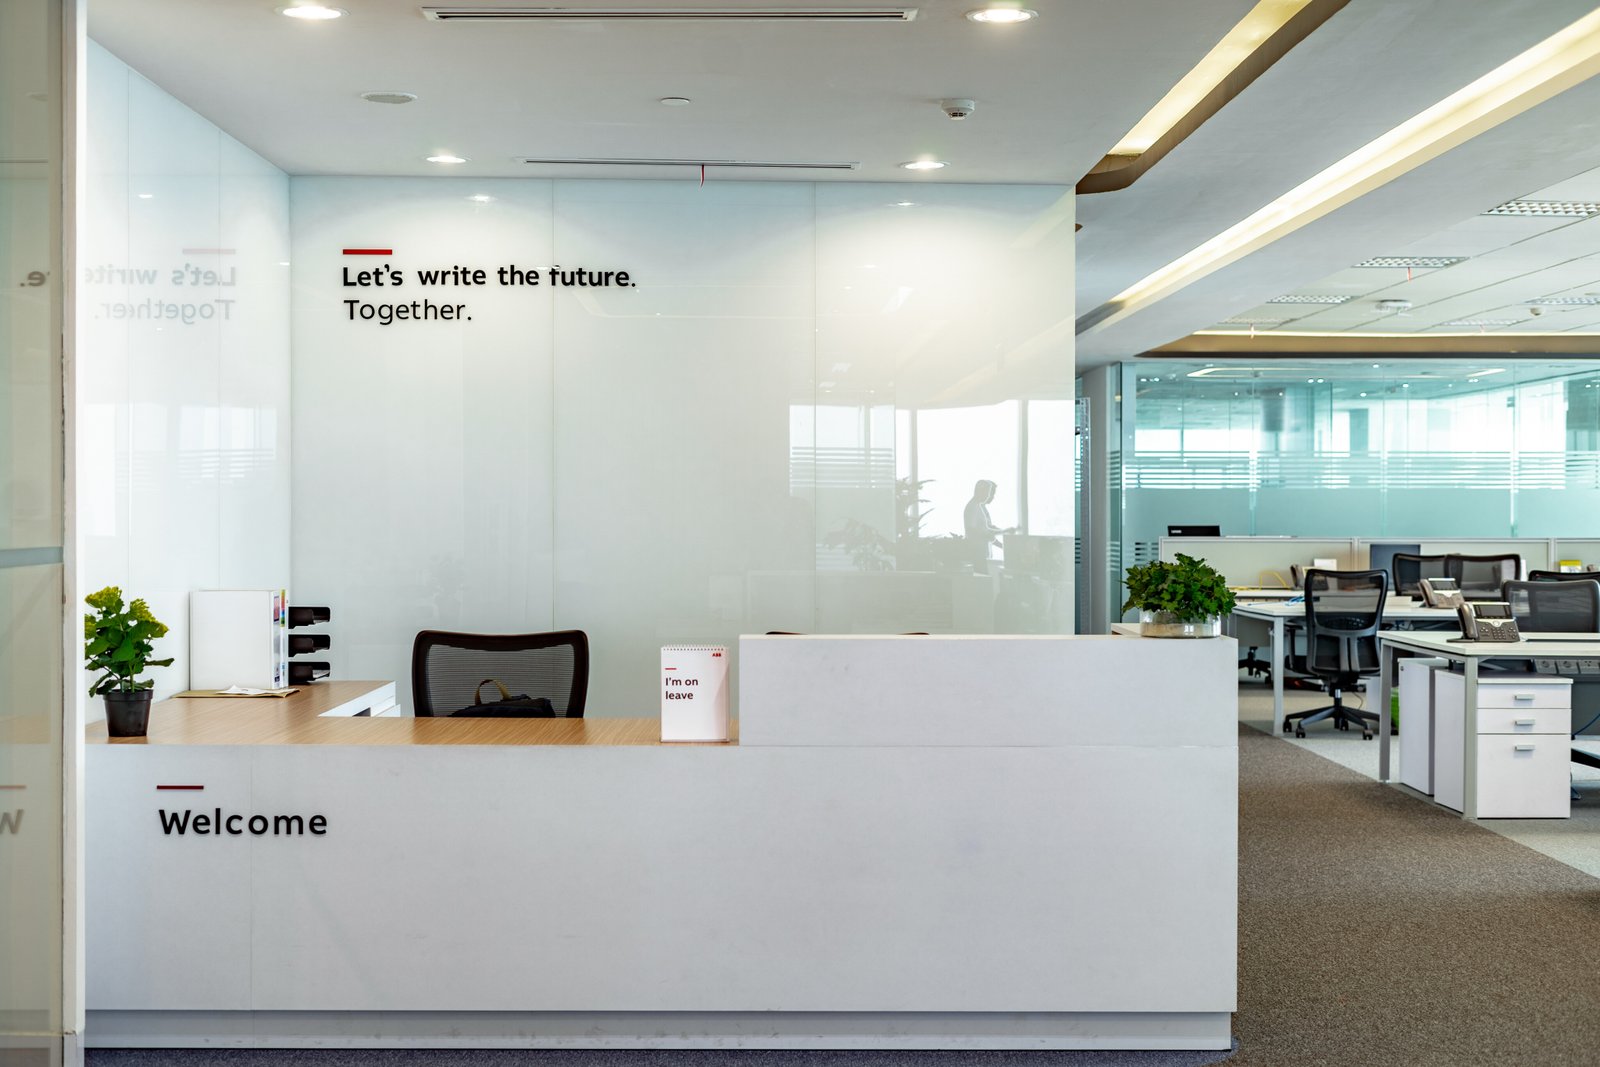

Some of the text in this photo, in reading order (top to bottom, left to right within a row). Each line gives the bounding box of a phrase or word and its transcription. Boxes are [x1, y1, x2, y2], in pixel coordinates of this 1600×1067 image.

[342, 264, 636, 287] Let's write the future.
[344, 299, 472, 325] Together.
[665, 678, 682, 686] I'm
[665, 690, 694, 700] leave
[158, 807, 328, 836] Welcome
